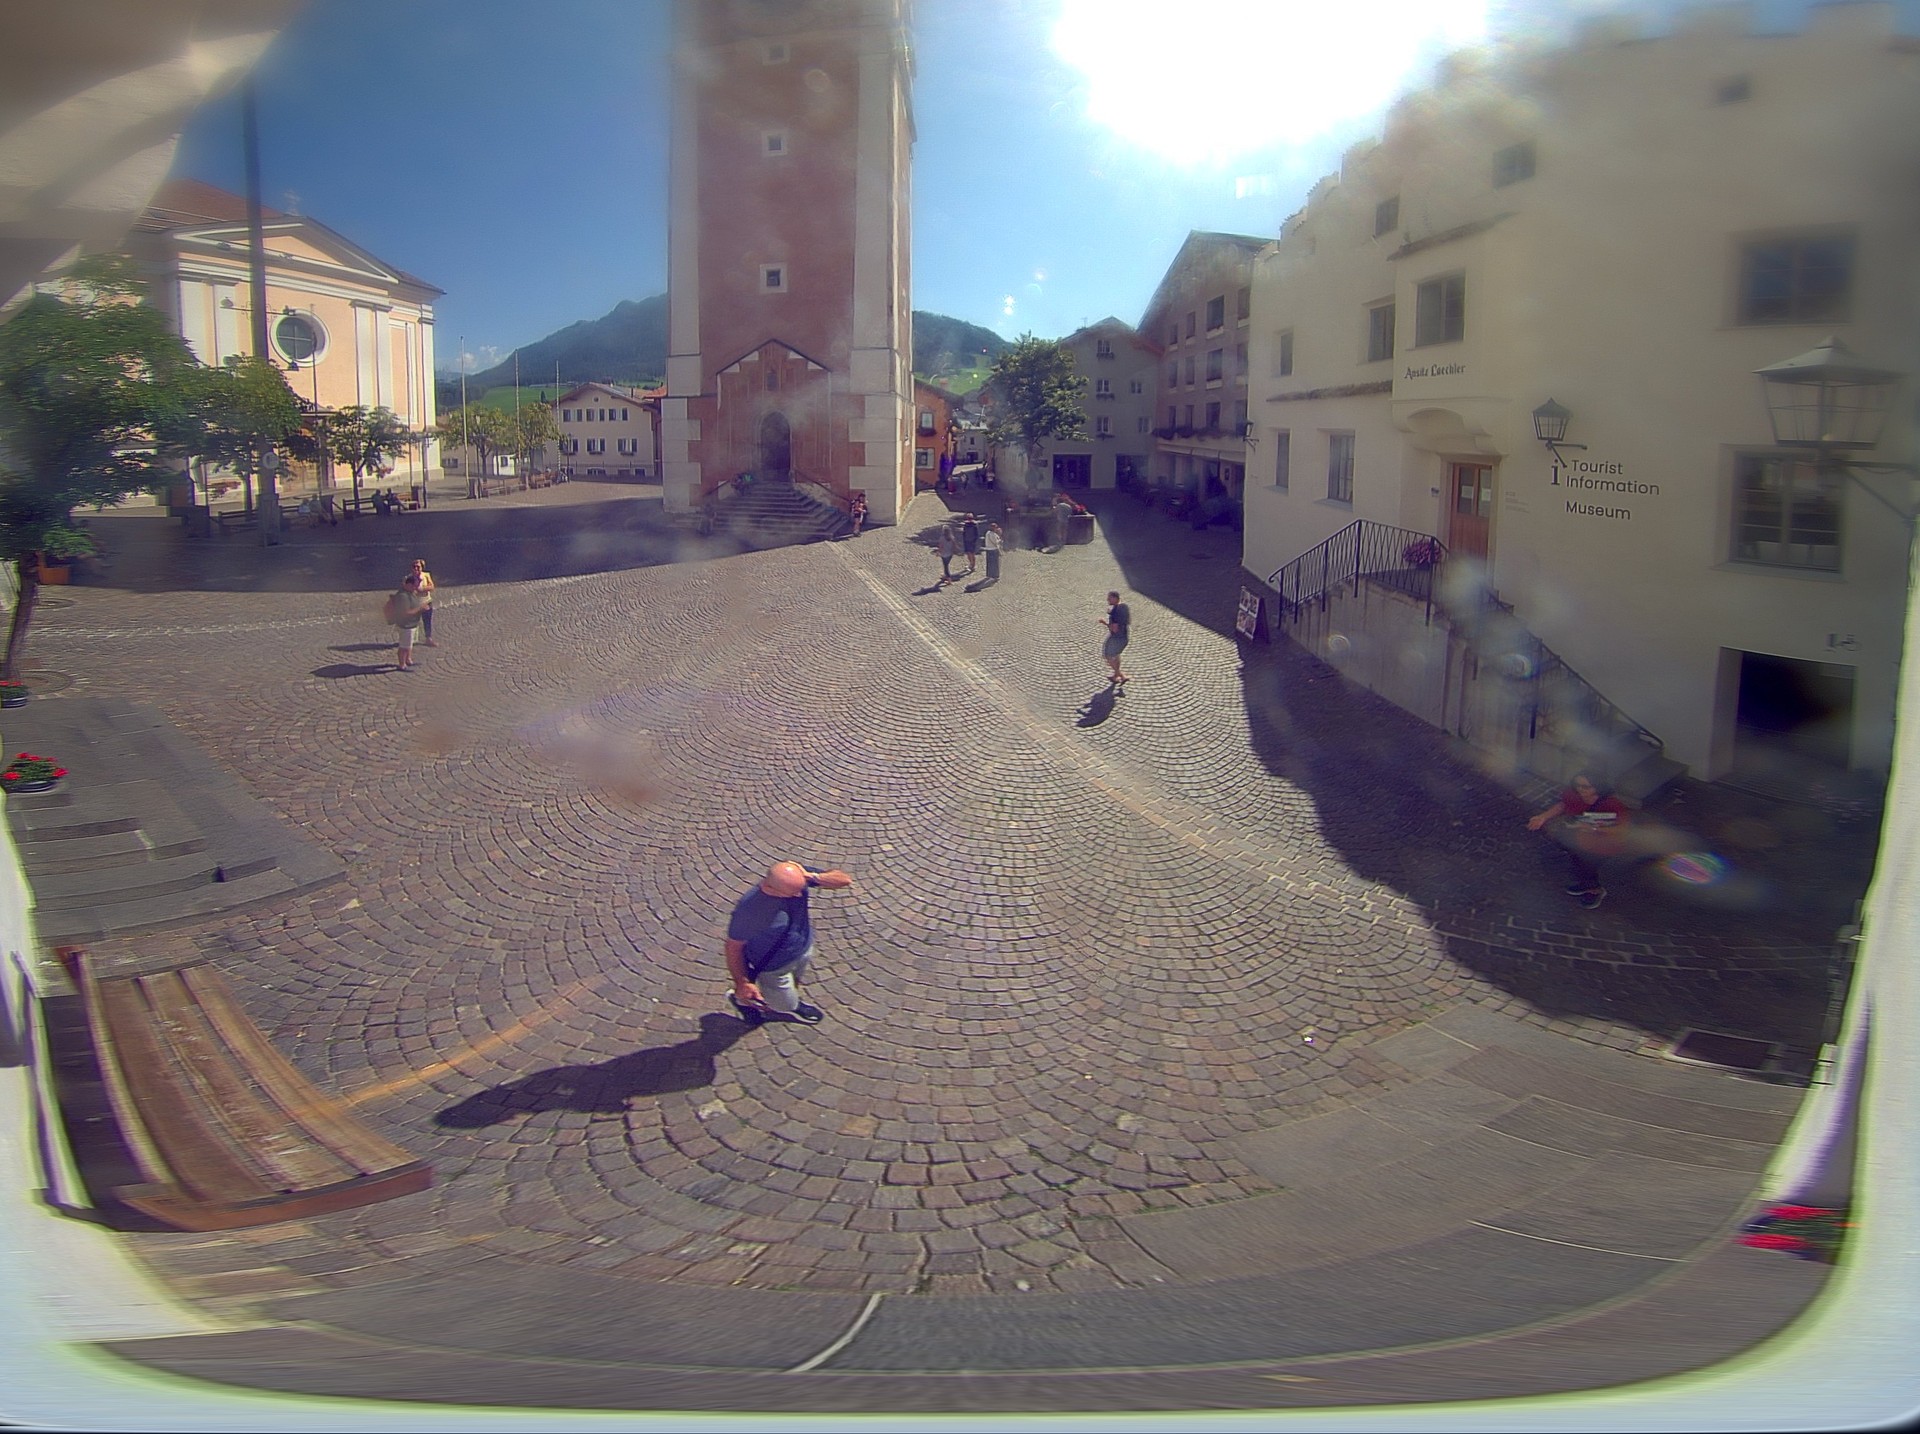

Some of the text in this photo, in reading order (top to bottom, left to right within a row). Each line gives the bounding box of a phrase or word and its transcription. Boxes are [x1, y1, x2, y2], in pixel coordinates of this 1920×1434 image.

[1571, 460, 1624, 475] Tourist
[1566, 475, 1660, 496] Information
[1566, 501, 1631, 520] Museum
